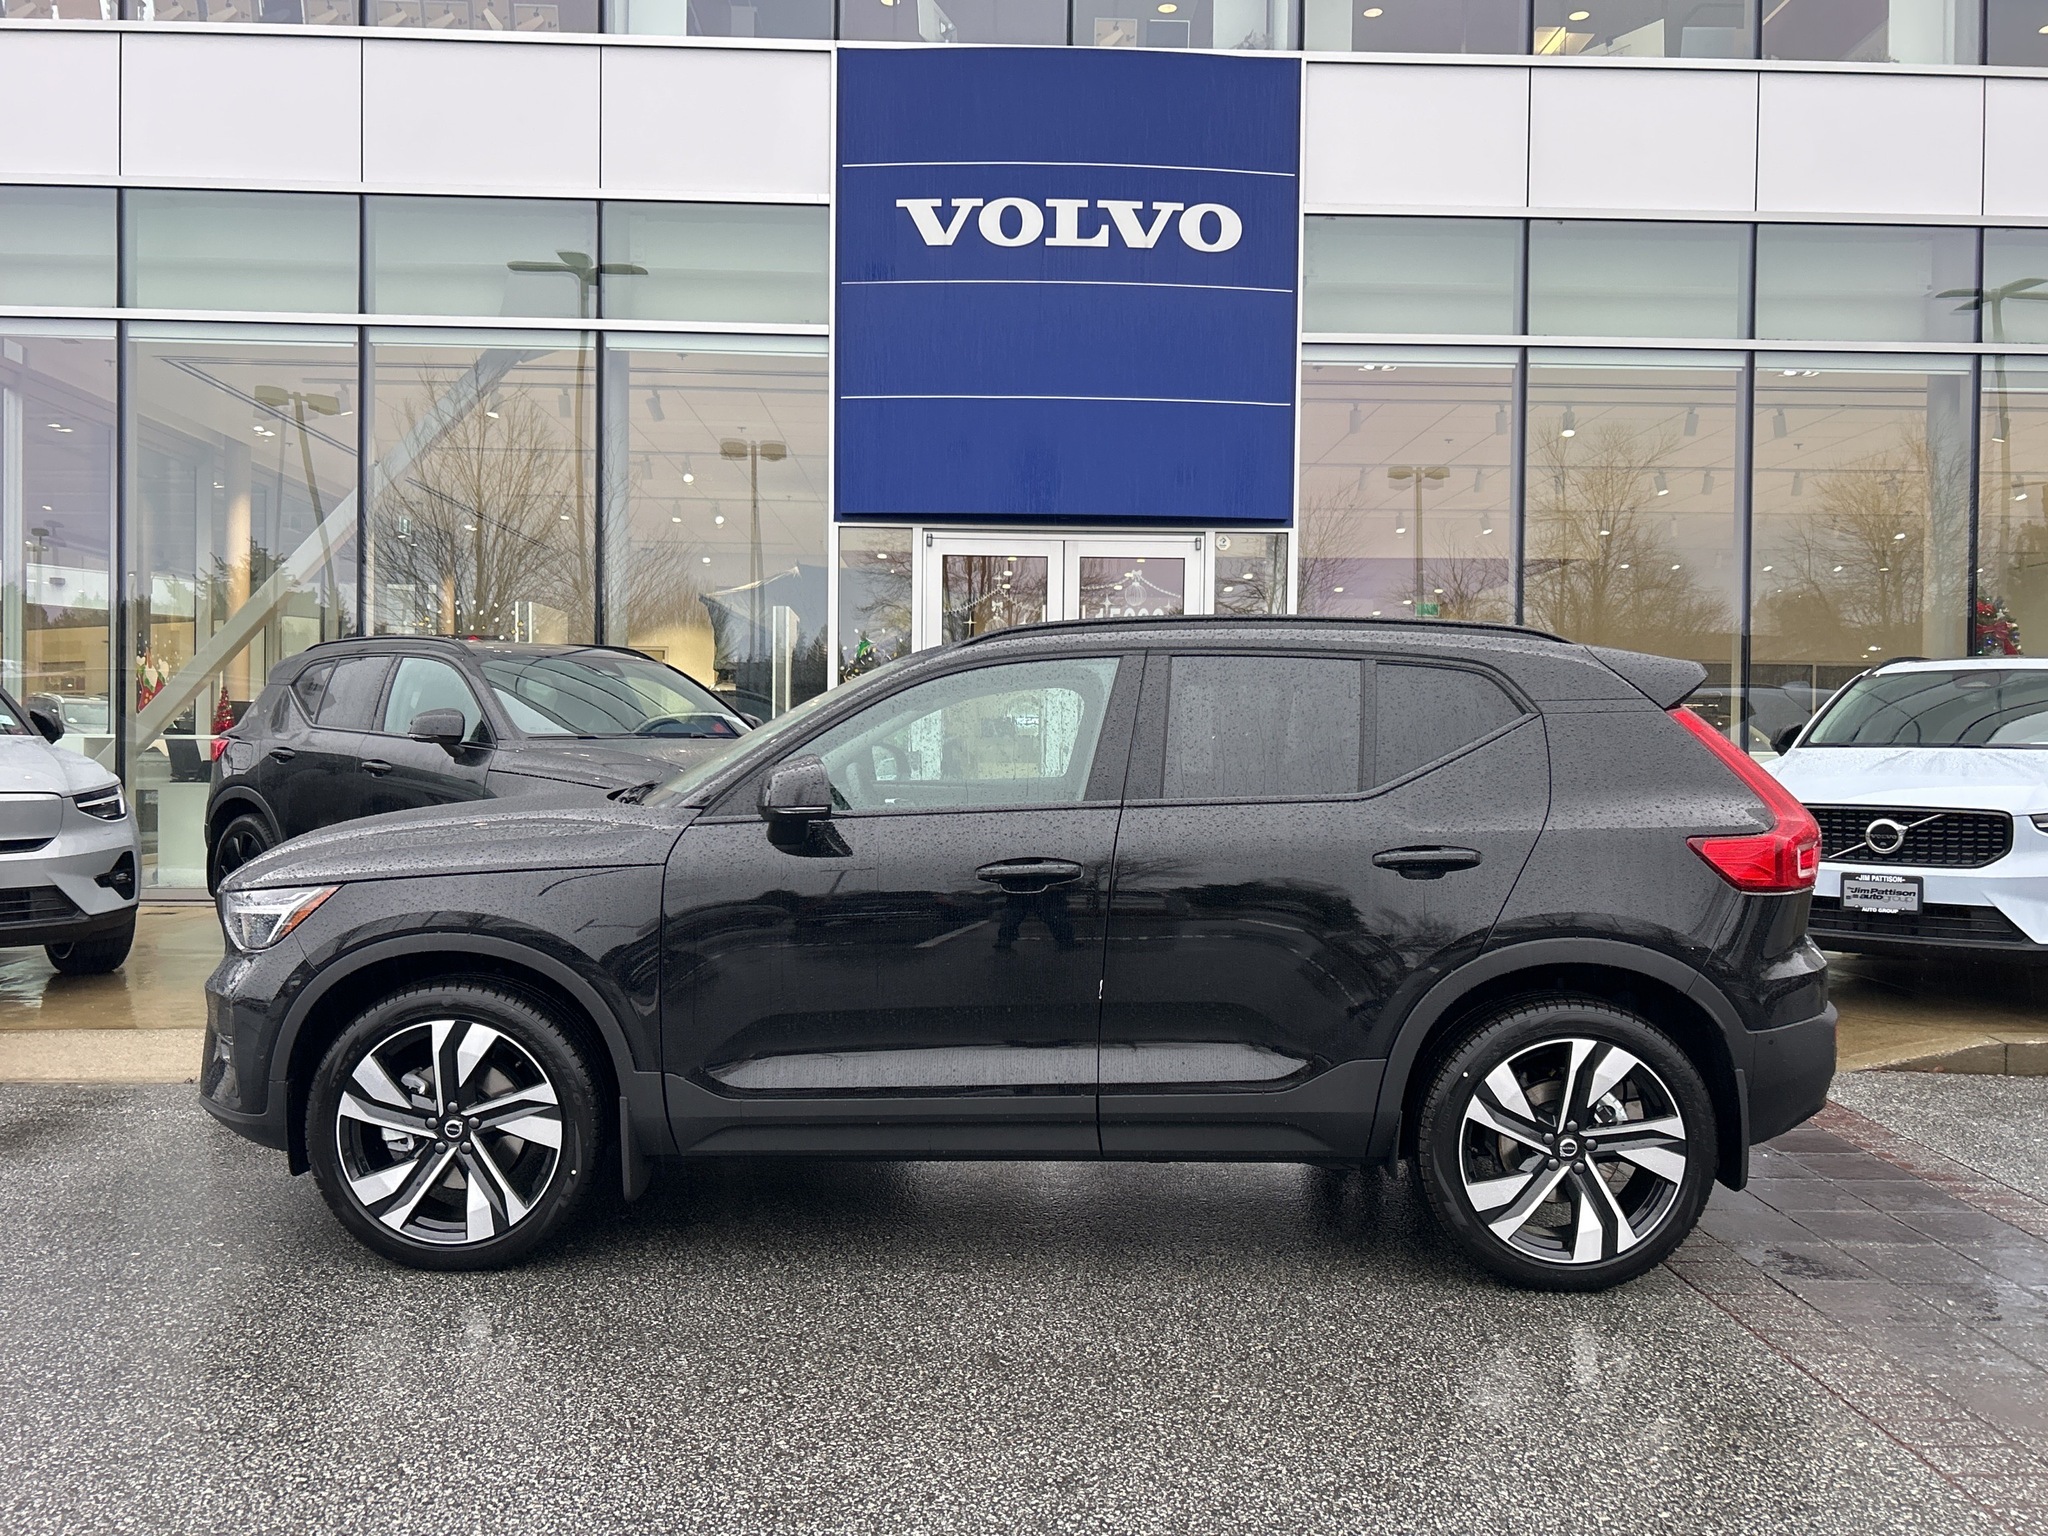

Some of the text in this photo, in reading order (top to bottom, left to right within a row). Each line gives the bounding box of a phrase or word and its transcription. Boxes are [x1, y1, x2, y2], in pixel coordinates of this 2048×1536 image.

[896, 197, 1243, 253] VOLVO
[1859, 874, 1903, 883] JIM PATTISON
[1870, 888, 1916, 897] Pattison
